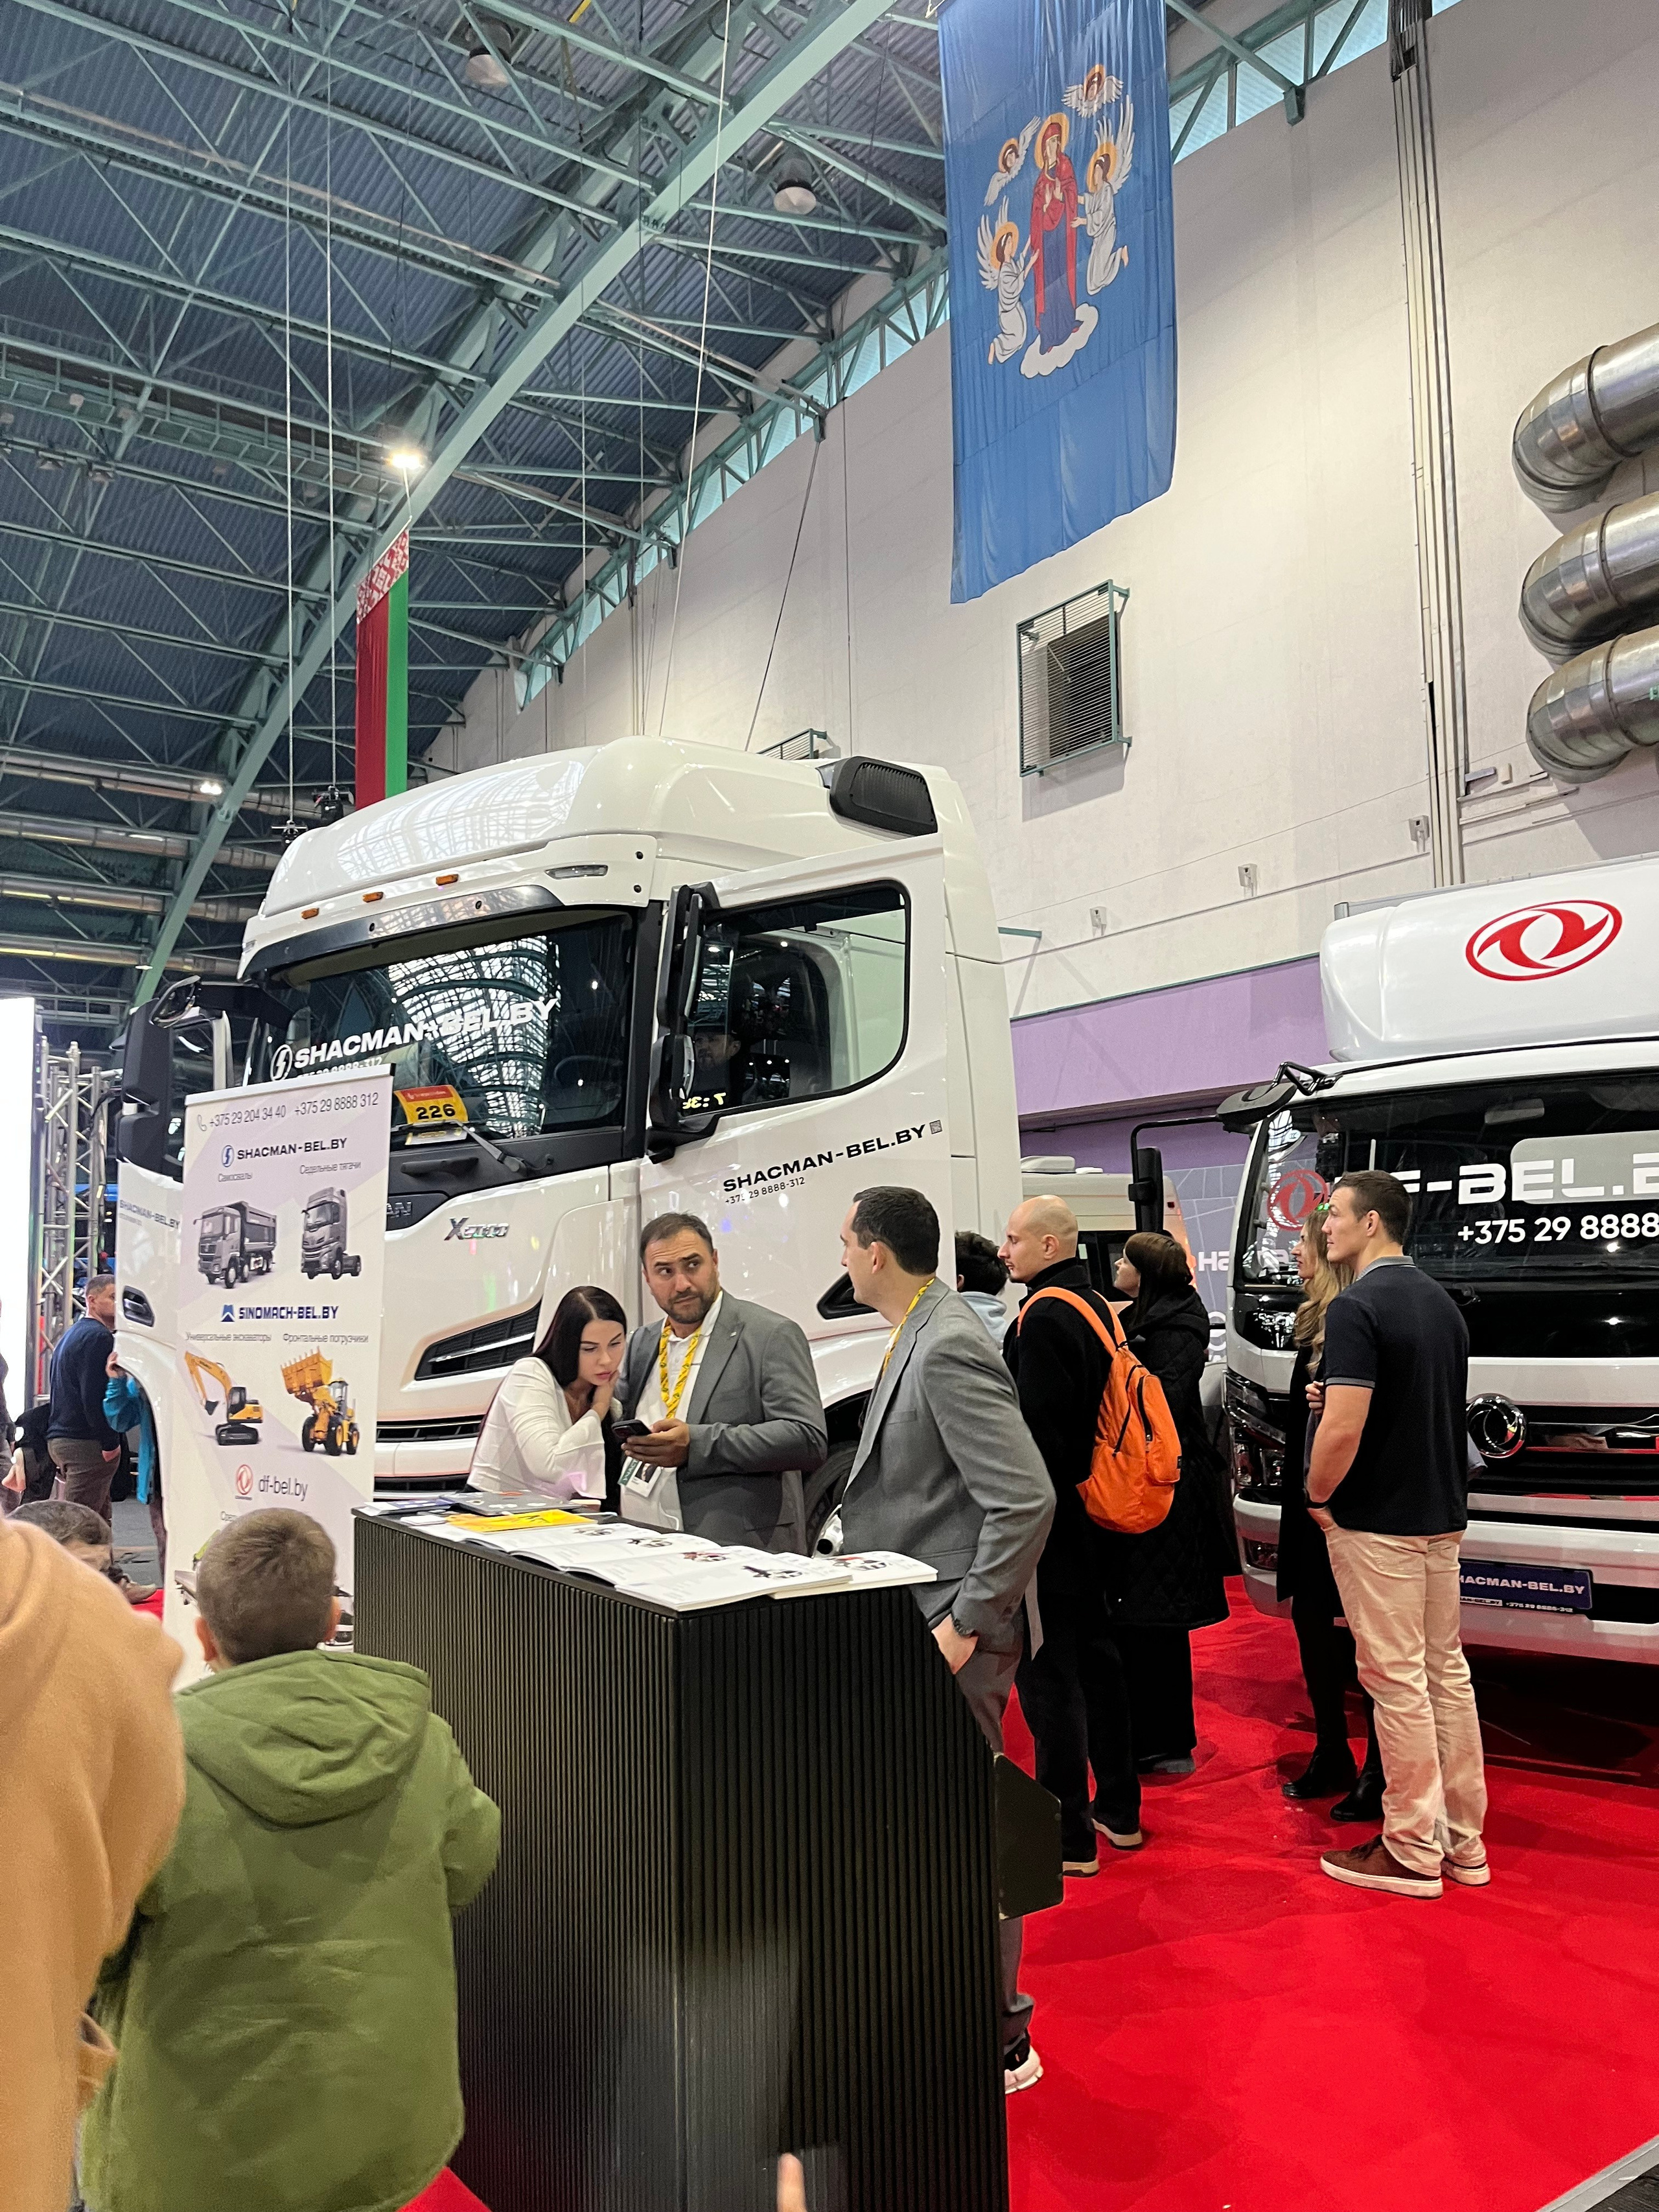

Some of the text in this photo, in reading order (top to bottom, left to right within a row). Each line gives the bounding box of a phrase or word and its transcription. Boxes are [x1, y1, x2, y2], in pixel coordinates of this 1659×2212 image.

[294, 999, 558, 1068] SHACMAN-BEL.BY
[209, 1092, 378, 1128] +375 29 204 34 40 +375 29 8888 312
[416, 1104, 456, 1120] 226
[237, 1137, 347, 1160] SHACMAN-BEL.BY
[723, 1124, 925, 1192] SHACMAN-BEL.BY
[299, 1161, 362, 1175] Седельные тягачи
[748, 1189, 760, 1199] 29
[761, 1176, 805, 1195] 8888-312
[1458, 1212, 1659, 1244] +375 29 8888
[238, 1305, 340, 1320] SINOMACH-BEL.BY
[185, 1331, 231, 1342] Универсальные
[283, 1333, 369, 1345] Фронтальные погрузчики
[259, 1474, 308, 1502] df-bel.by
[1459, 1575, 1585, 1595] HACMAN-BEL.BY
